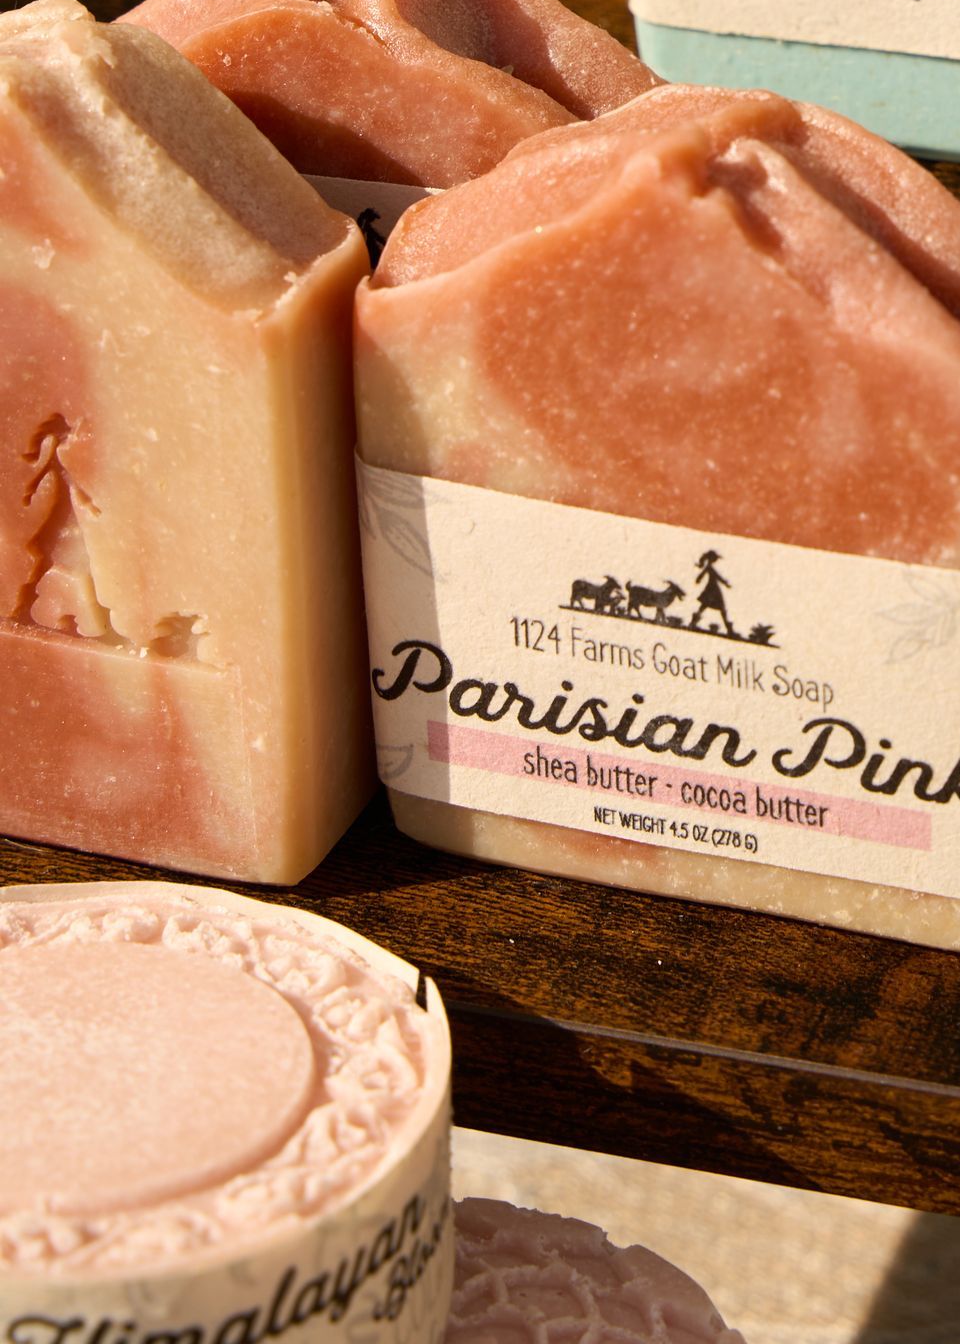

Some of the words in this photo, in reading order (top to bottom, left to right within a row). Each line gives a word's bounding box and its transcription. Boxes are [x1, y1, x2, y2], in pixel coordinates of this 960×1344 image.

[371, 640, 757, 769] Parisian
[510, 617, 562, 655] 1124
[569, 626, 645, 671] Farms
[652, 642, 709, 683] Goat
[716, 654, 766, 693] Milk
[771, 665, 834, 713] Soap
[523, 746, 578, 784] shea
[586, 755, 657, 798] butter
[680, 780, 748, 816] cocoa
[755, 786, 829, 829] butter
[593, 806, 617, 825] NET
[618, 811, 667, 836] WEIGHT
[669, 821, 689, 839] 4.5
[692, 825, 710, 844] OZ
[711, 828, 742, 850] (278
[744, 833, 759, 855] G)
[4, 1193, 425, 1344] alayan
